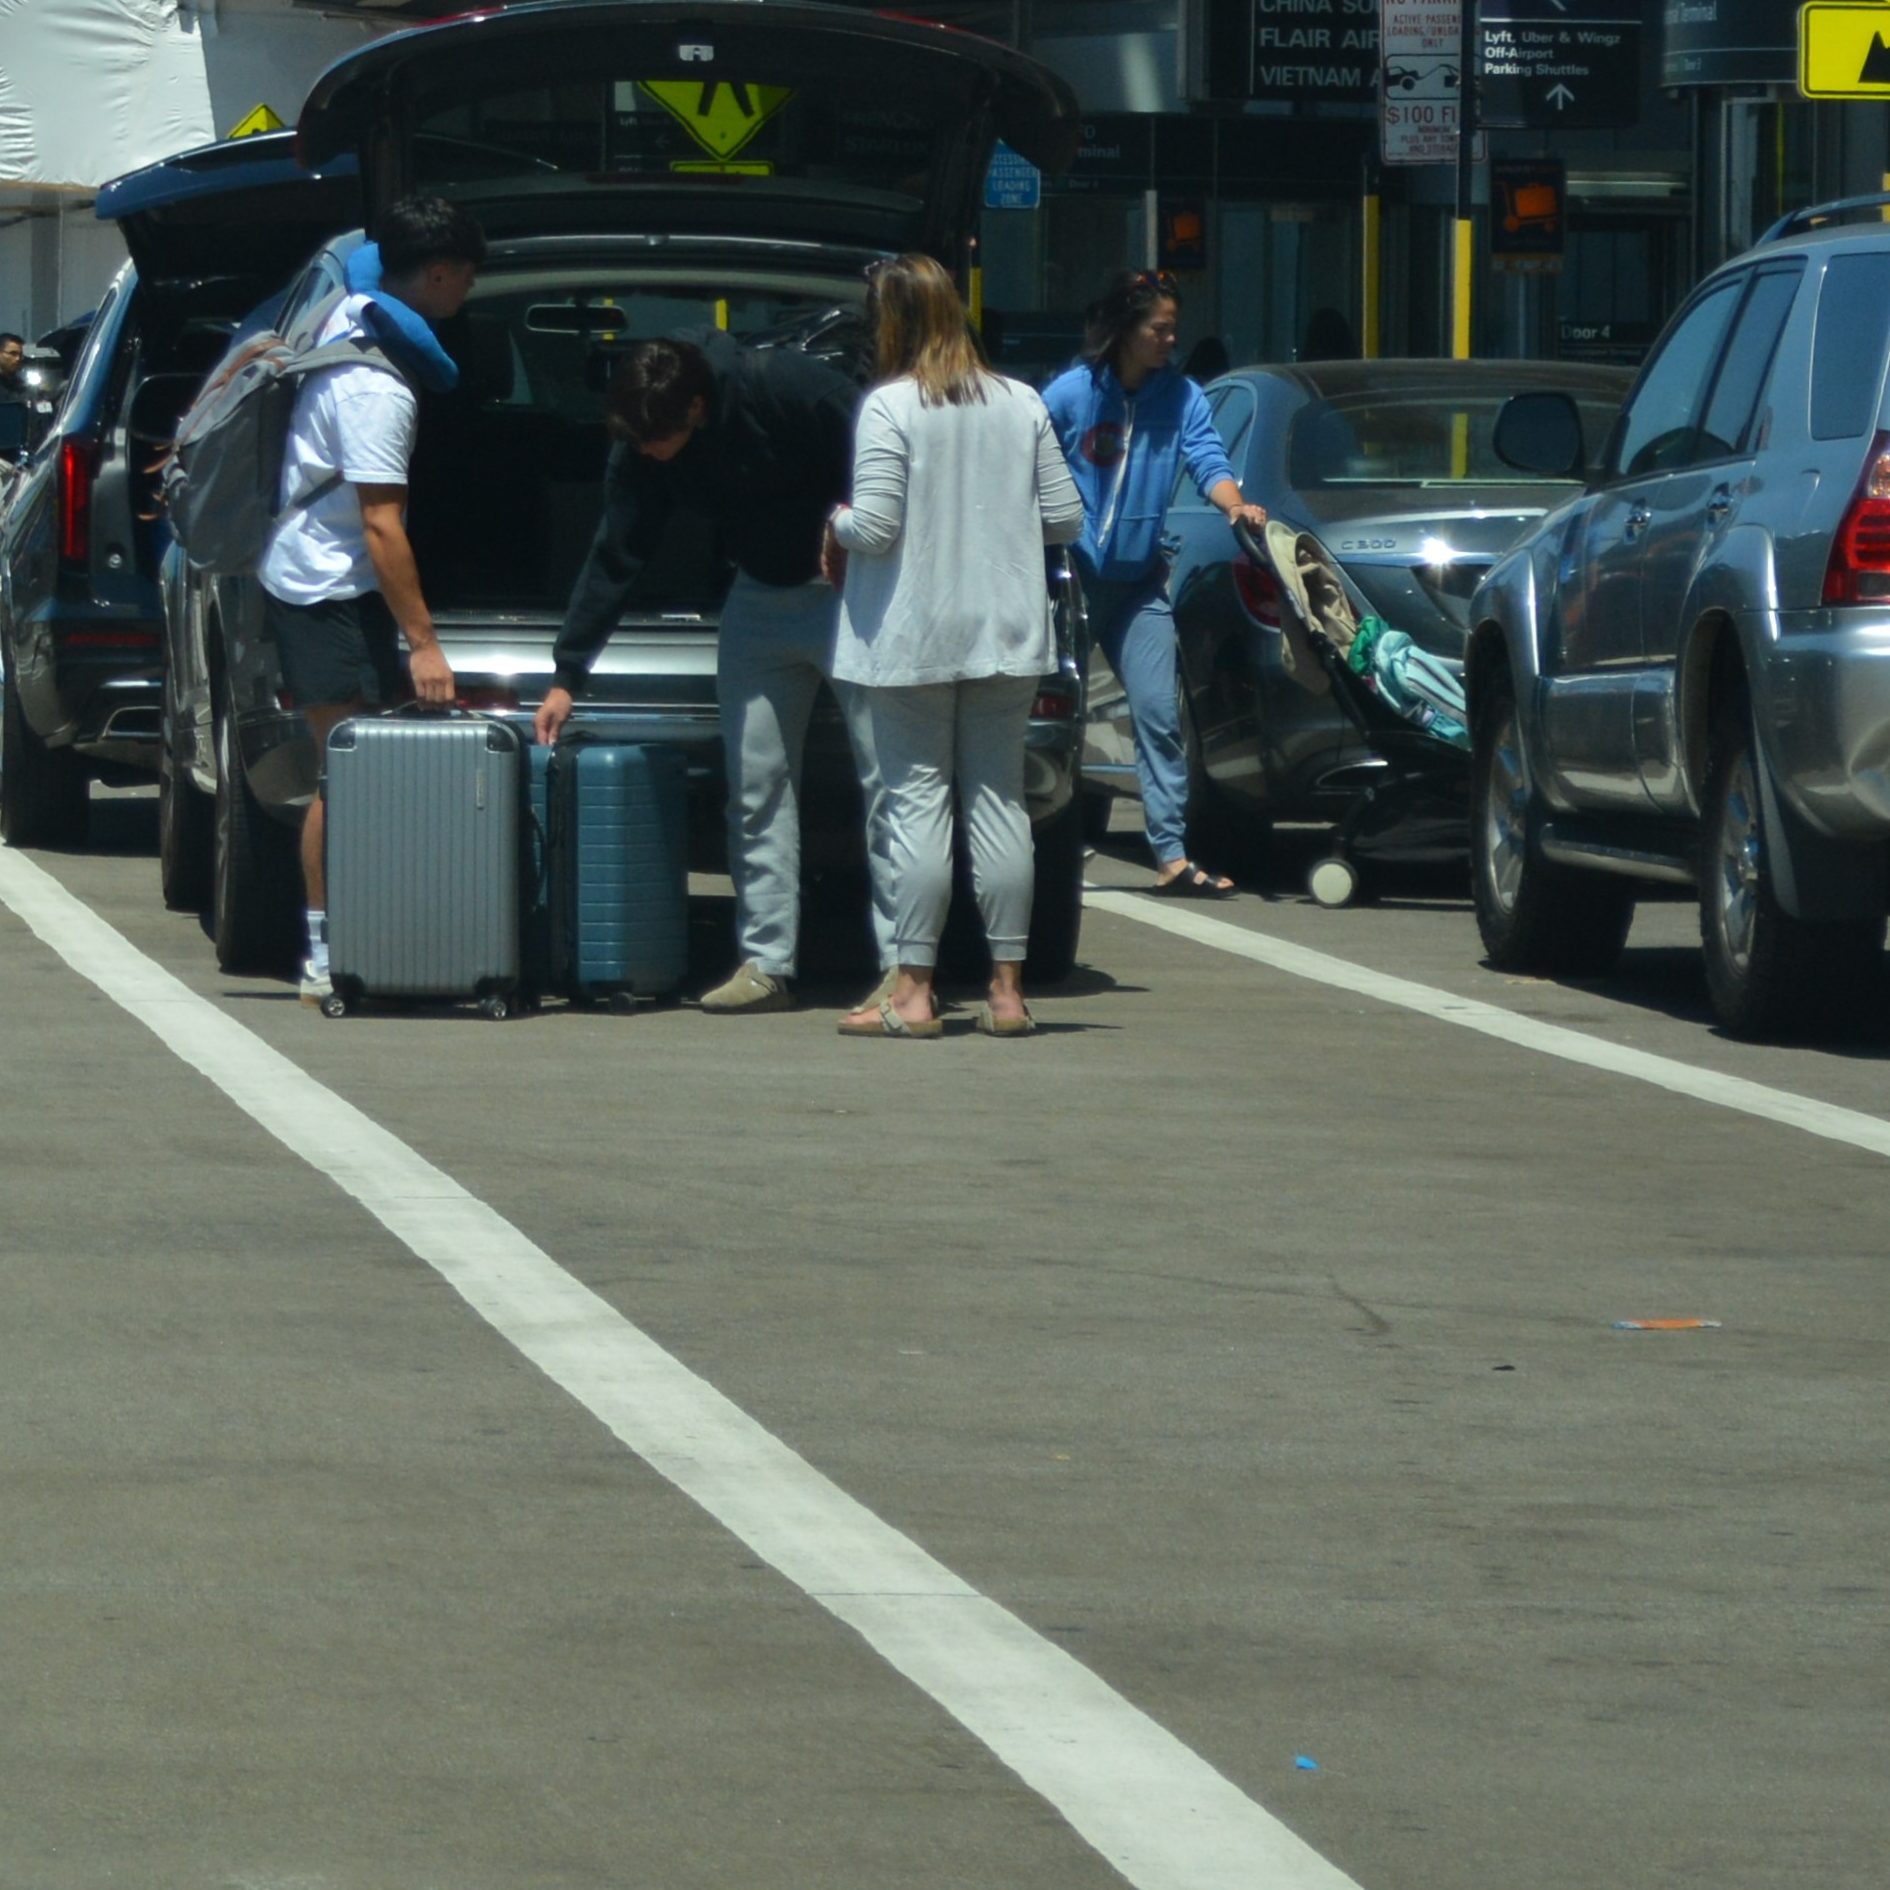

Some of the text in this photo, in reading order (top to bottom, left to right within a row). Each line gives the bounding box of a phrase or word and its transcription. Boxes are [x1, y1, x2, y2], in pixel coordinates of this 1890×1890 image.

[1260, 27, 1332, 48] FLAIR
[1522, 31, 1554, 43] Uber
[1577, 31, 1621, 47] Wingz
[1484, 47, 1554, 60] Off-Airport
[1260, 65, 1361, 87] VIETNAM
[1484, 62, 1589, 77] Parking Shuttles
[1386, 105, 1456, 125] $100 FI
[1078, 144, 1121, 158] minal
[1561, 324, 1611, 340] Door 4
